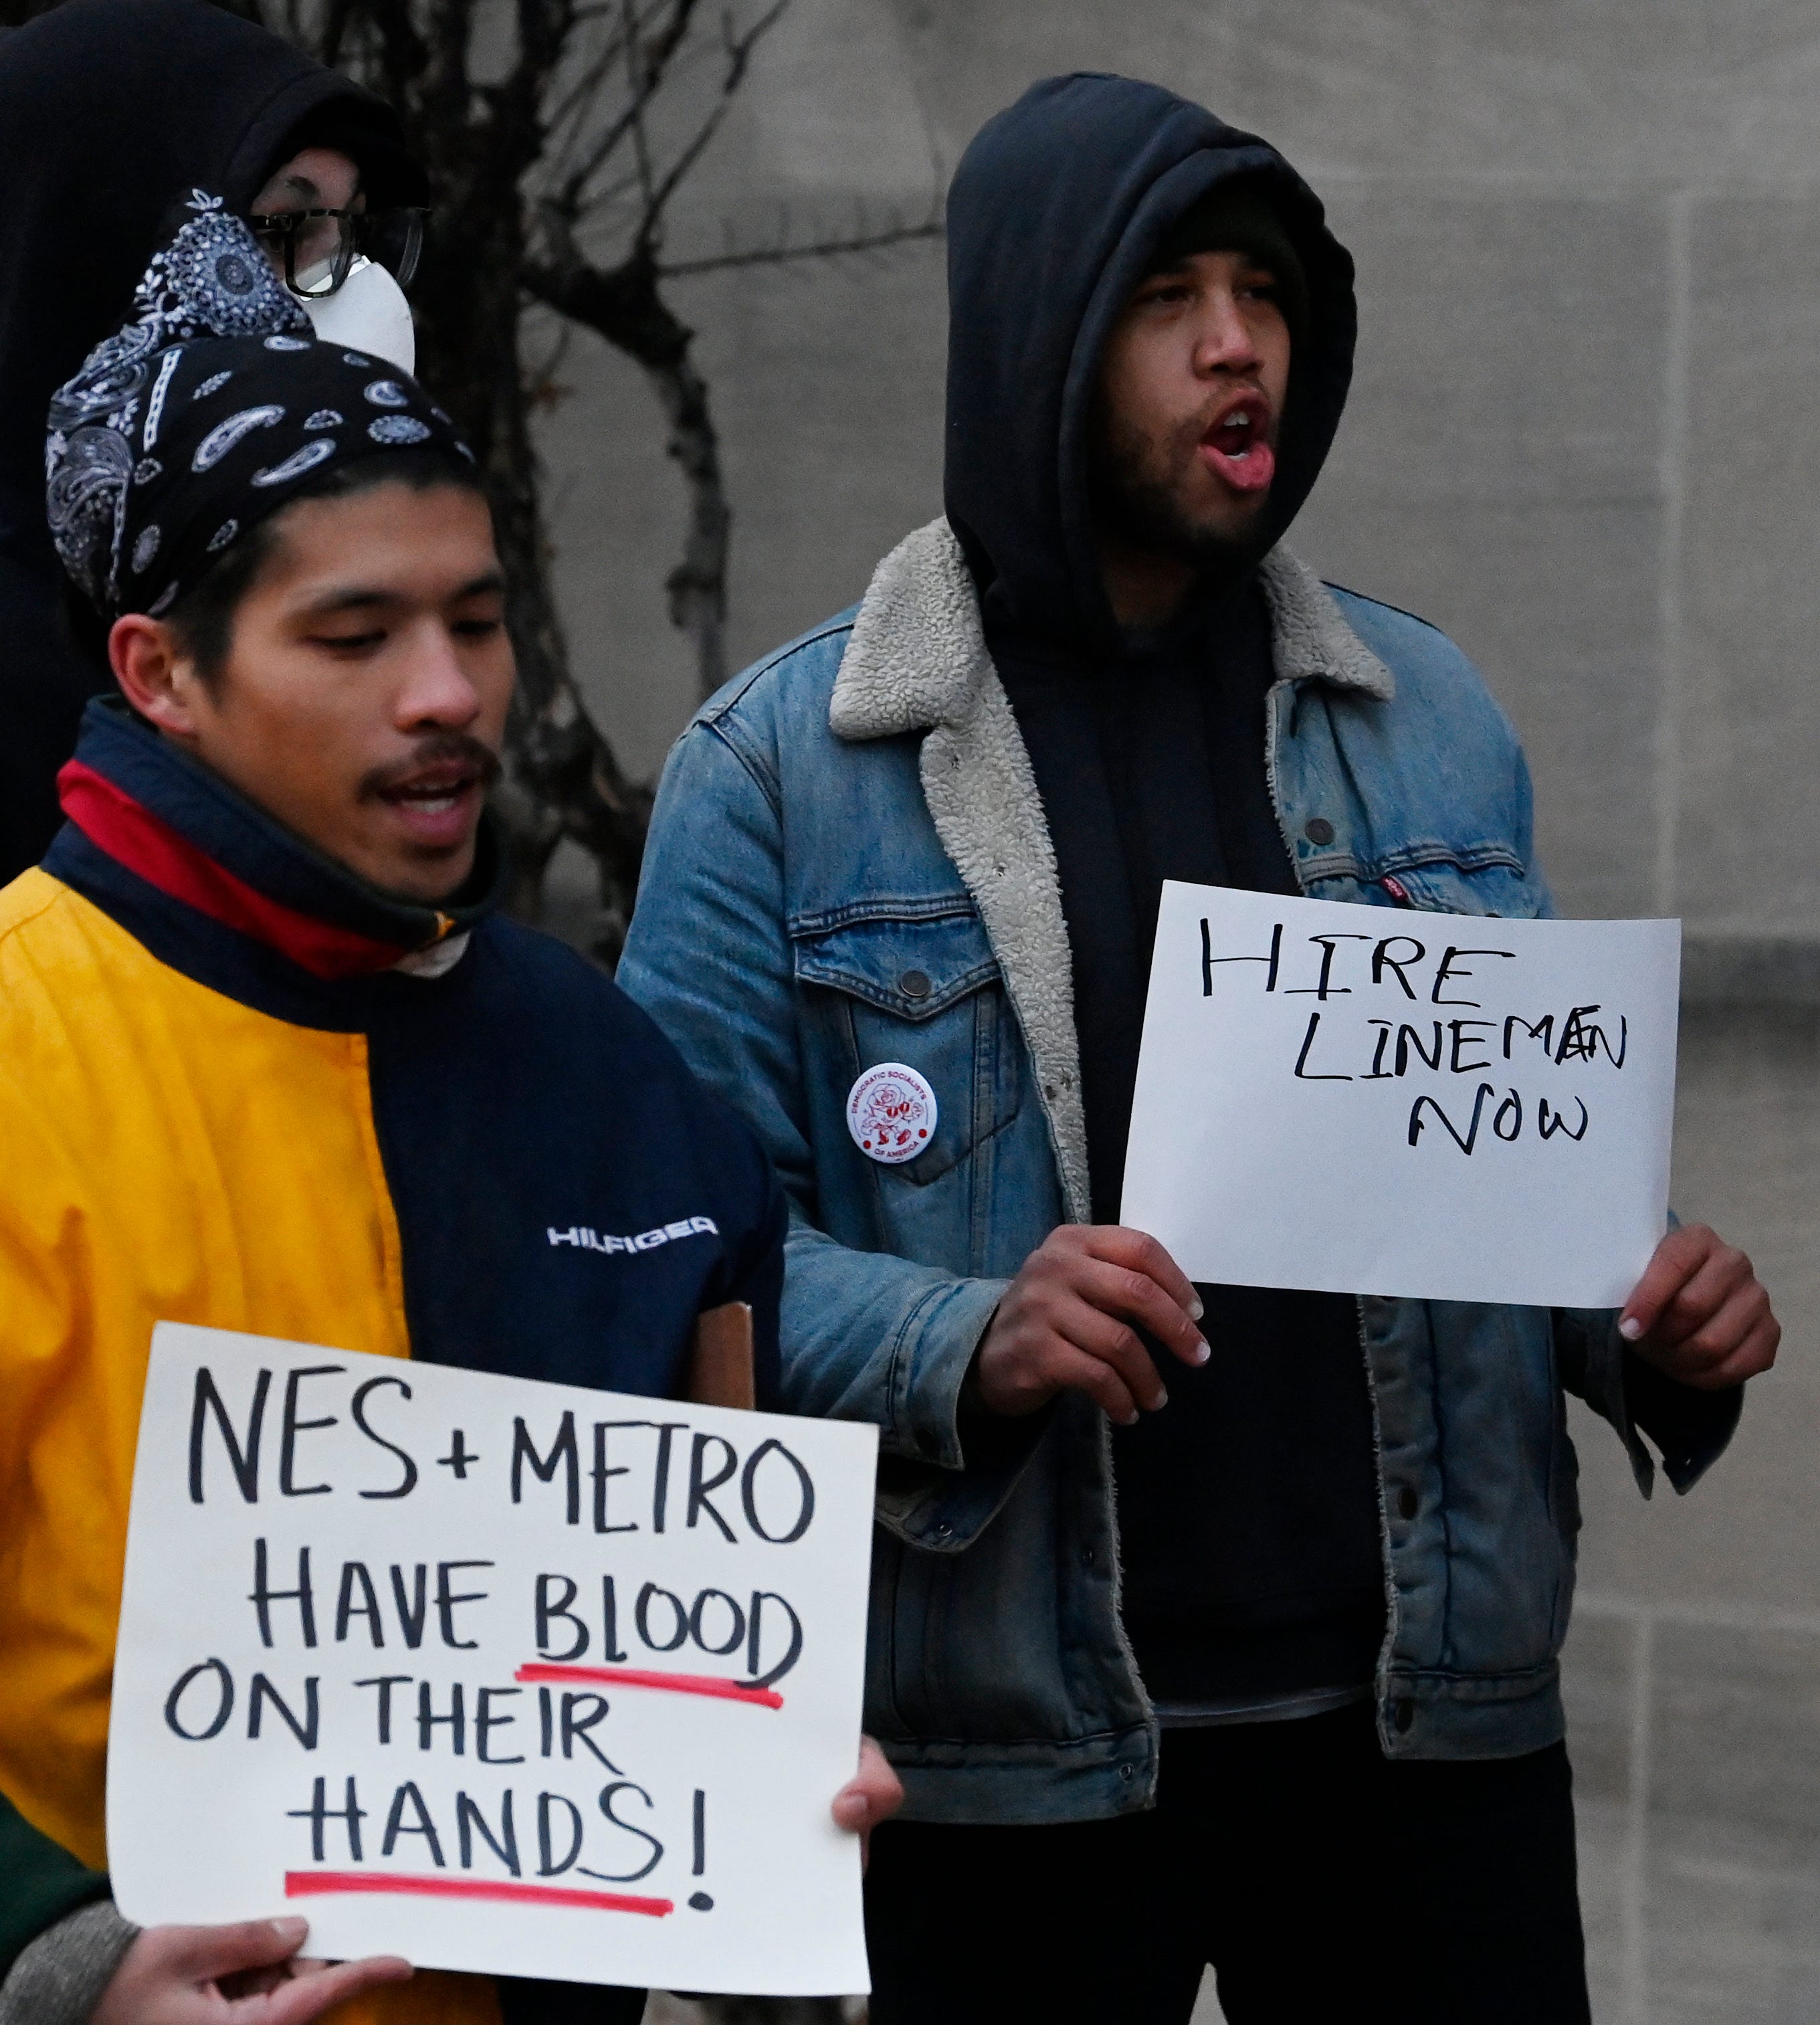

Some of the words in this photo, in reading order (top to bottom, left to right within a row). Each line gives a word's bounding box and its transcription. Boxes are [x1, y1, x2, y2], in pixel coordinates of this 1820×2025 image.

[1200, 918, 1516, 1008] HIRE
[851, 1071, 886, 1114] DEMOCRATIC
[887, 1070, 928, 1100] SOCIALISTS
[1408, 1082, 1589, 1156] NOW
[874, 1147, 886, 1156] OF
[886, 1141, 920, 1157] AMERICA
[189, 1365, 418, 1505] NES
[511, 1410, 815, 1544] METRO
[247, 1538, 495, 1650] HAVE
[535, 1573, 803, 1690] BLOOD
[165, 1657, 320, 1751] ON
[355, 1676, 623, 1775] THEIR
[287, 1776, 714, 1911] HANDS!
